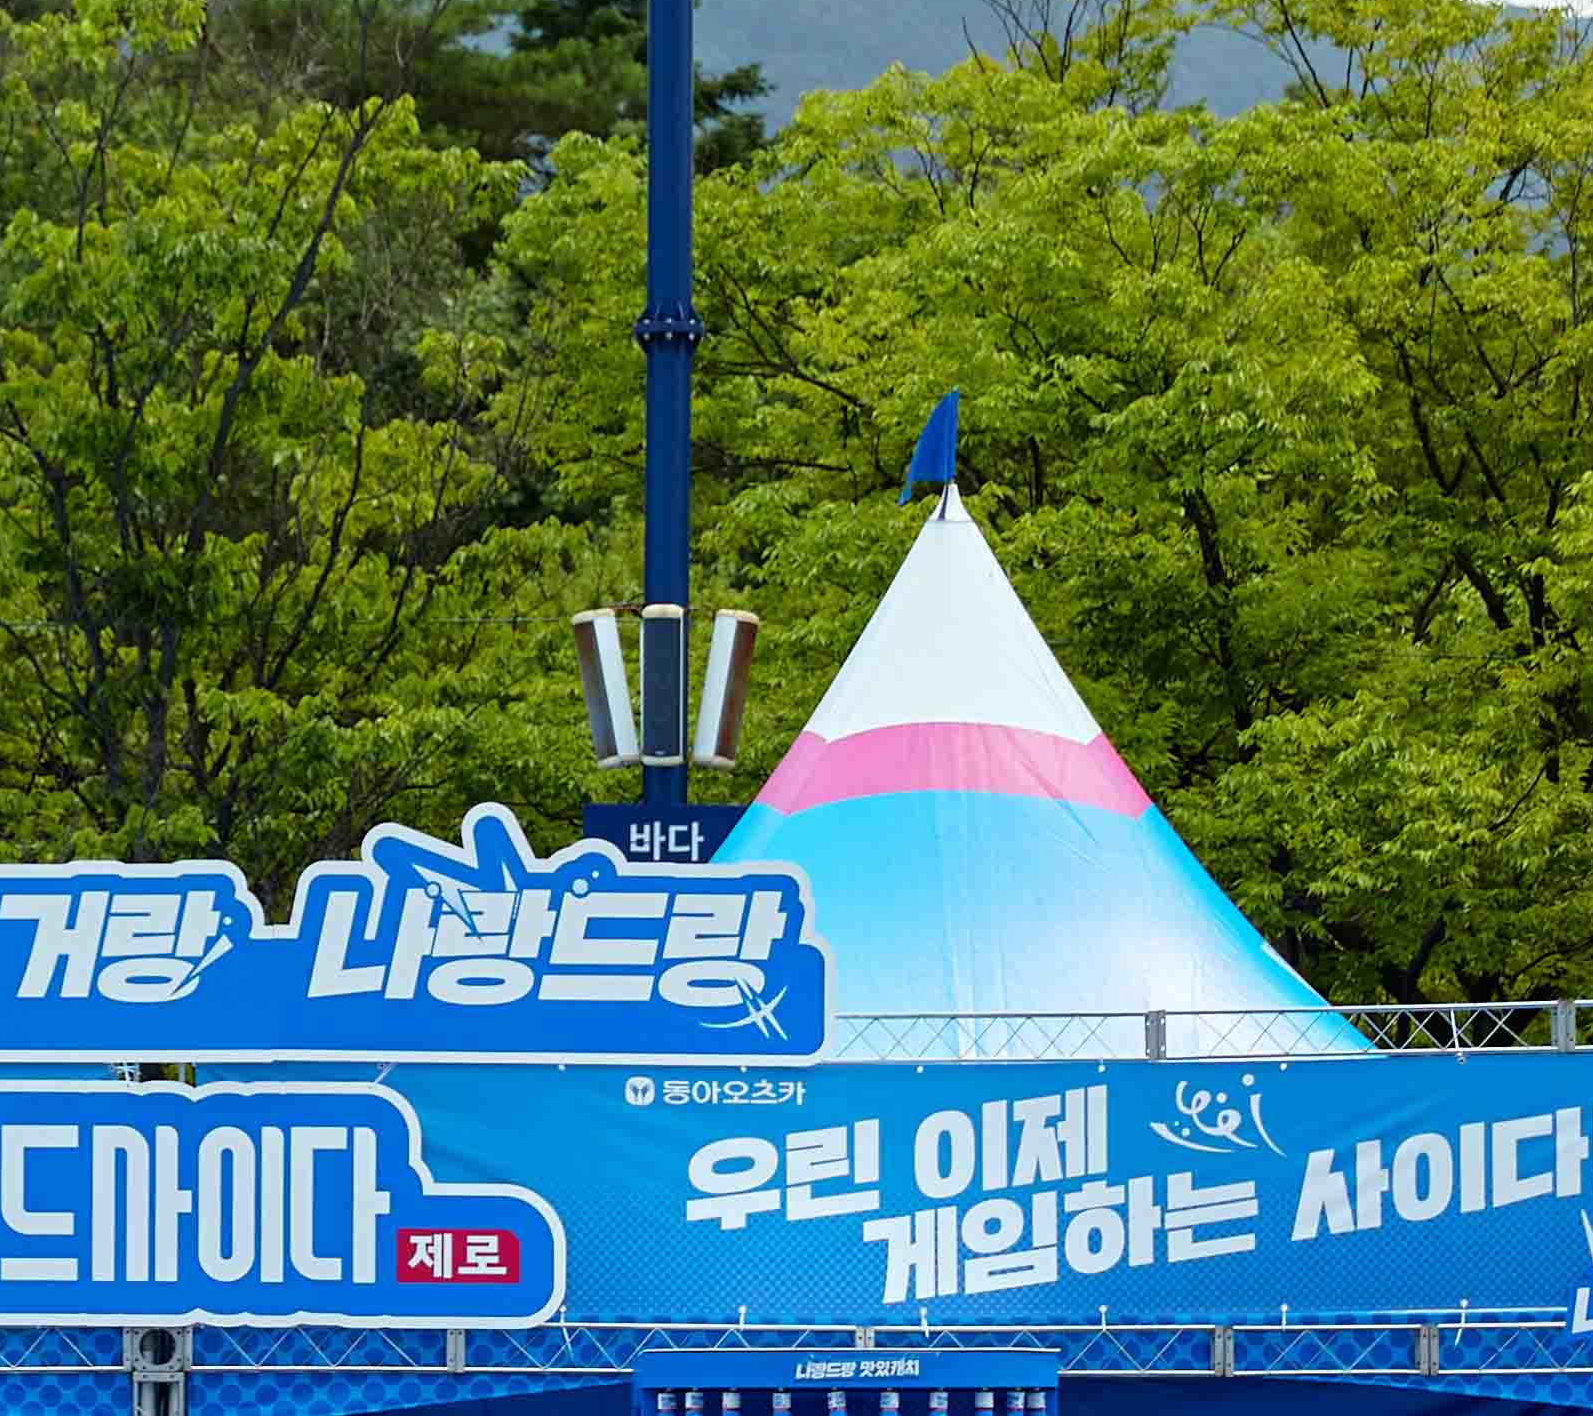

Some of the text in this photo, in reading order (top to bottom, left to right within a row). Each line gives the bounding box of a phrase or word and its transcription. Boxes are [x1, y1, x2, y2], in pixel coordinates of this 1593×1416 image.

[630, 821, 704, 862] 바다
[308, 887, 788, 1006] 나랑드랑
[662, 1076, 806, 1107] 동아오츠카
[685, 1084, 1108, 1230] 우린 이제
[408, 1230, 508, 1279] 제로
[862, 1172, 1258, 1304] 게임하는
[796, 1359, 919, 1380] 나랑드랑 맛있캐치
